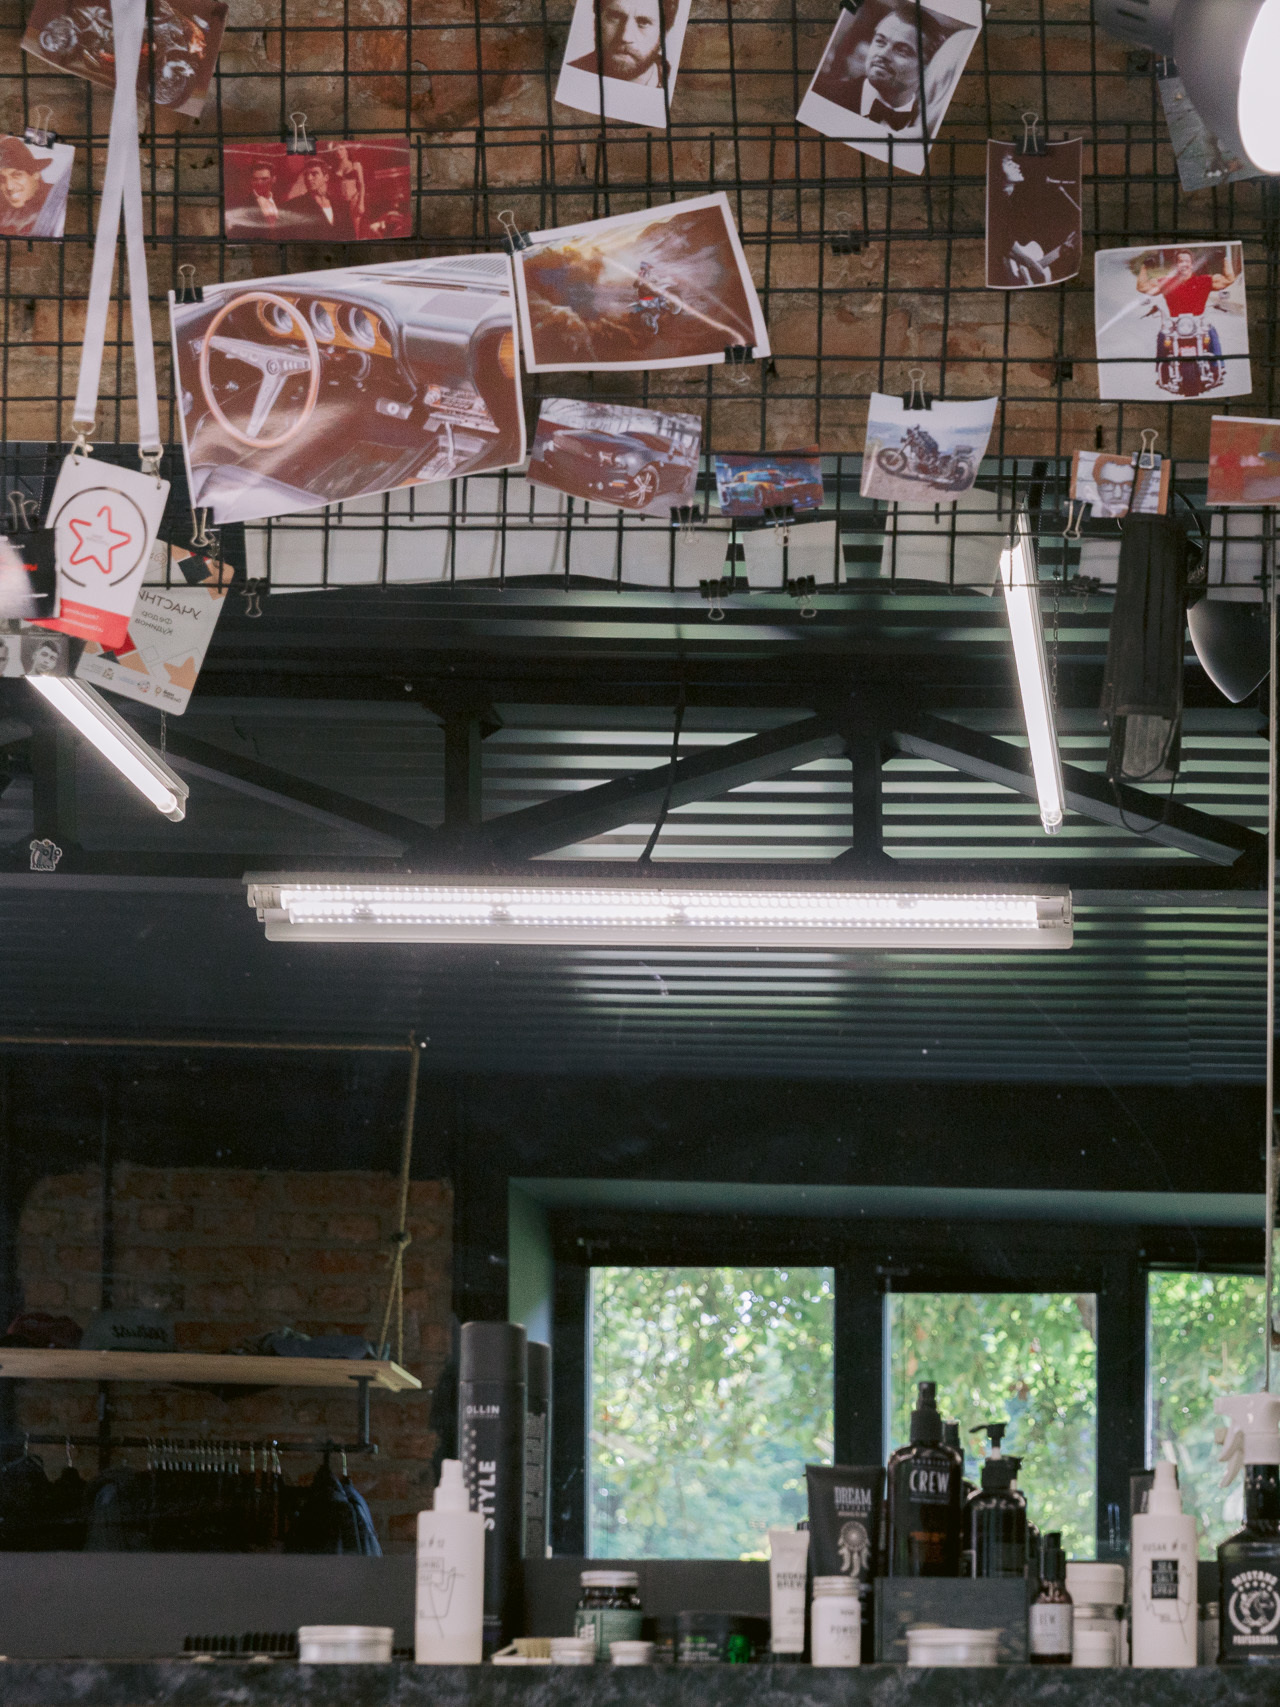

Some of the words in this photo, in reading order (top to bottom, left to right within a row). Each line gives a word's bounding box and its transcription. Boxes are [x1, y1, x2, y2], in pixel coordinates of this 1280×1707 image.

[466, 1404, 500, 1415] OLLIN
[909, 1469, 951, 1493] CREW
[478, 1460, 496, 1531] STYLE
[834, 1486, 872, 1505] DREAM
